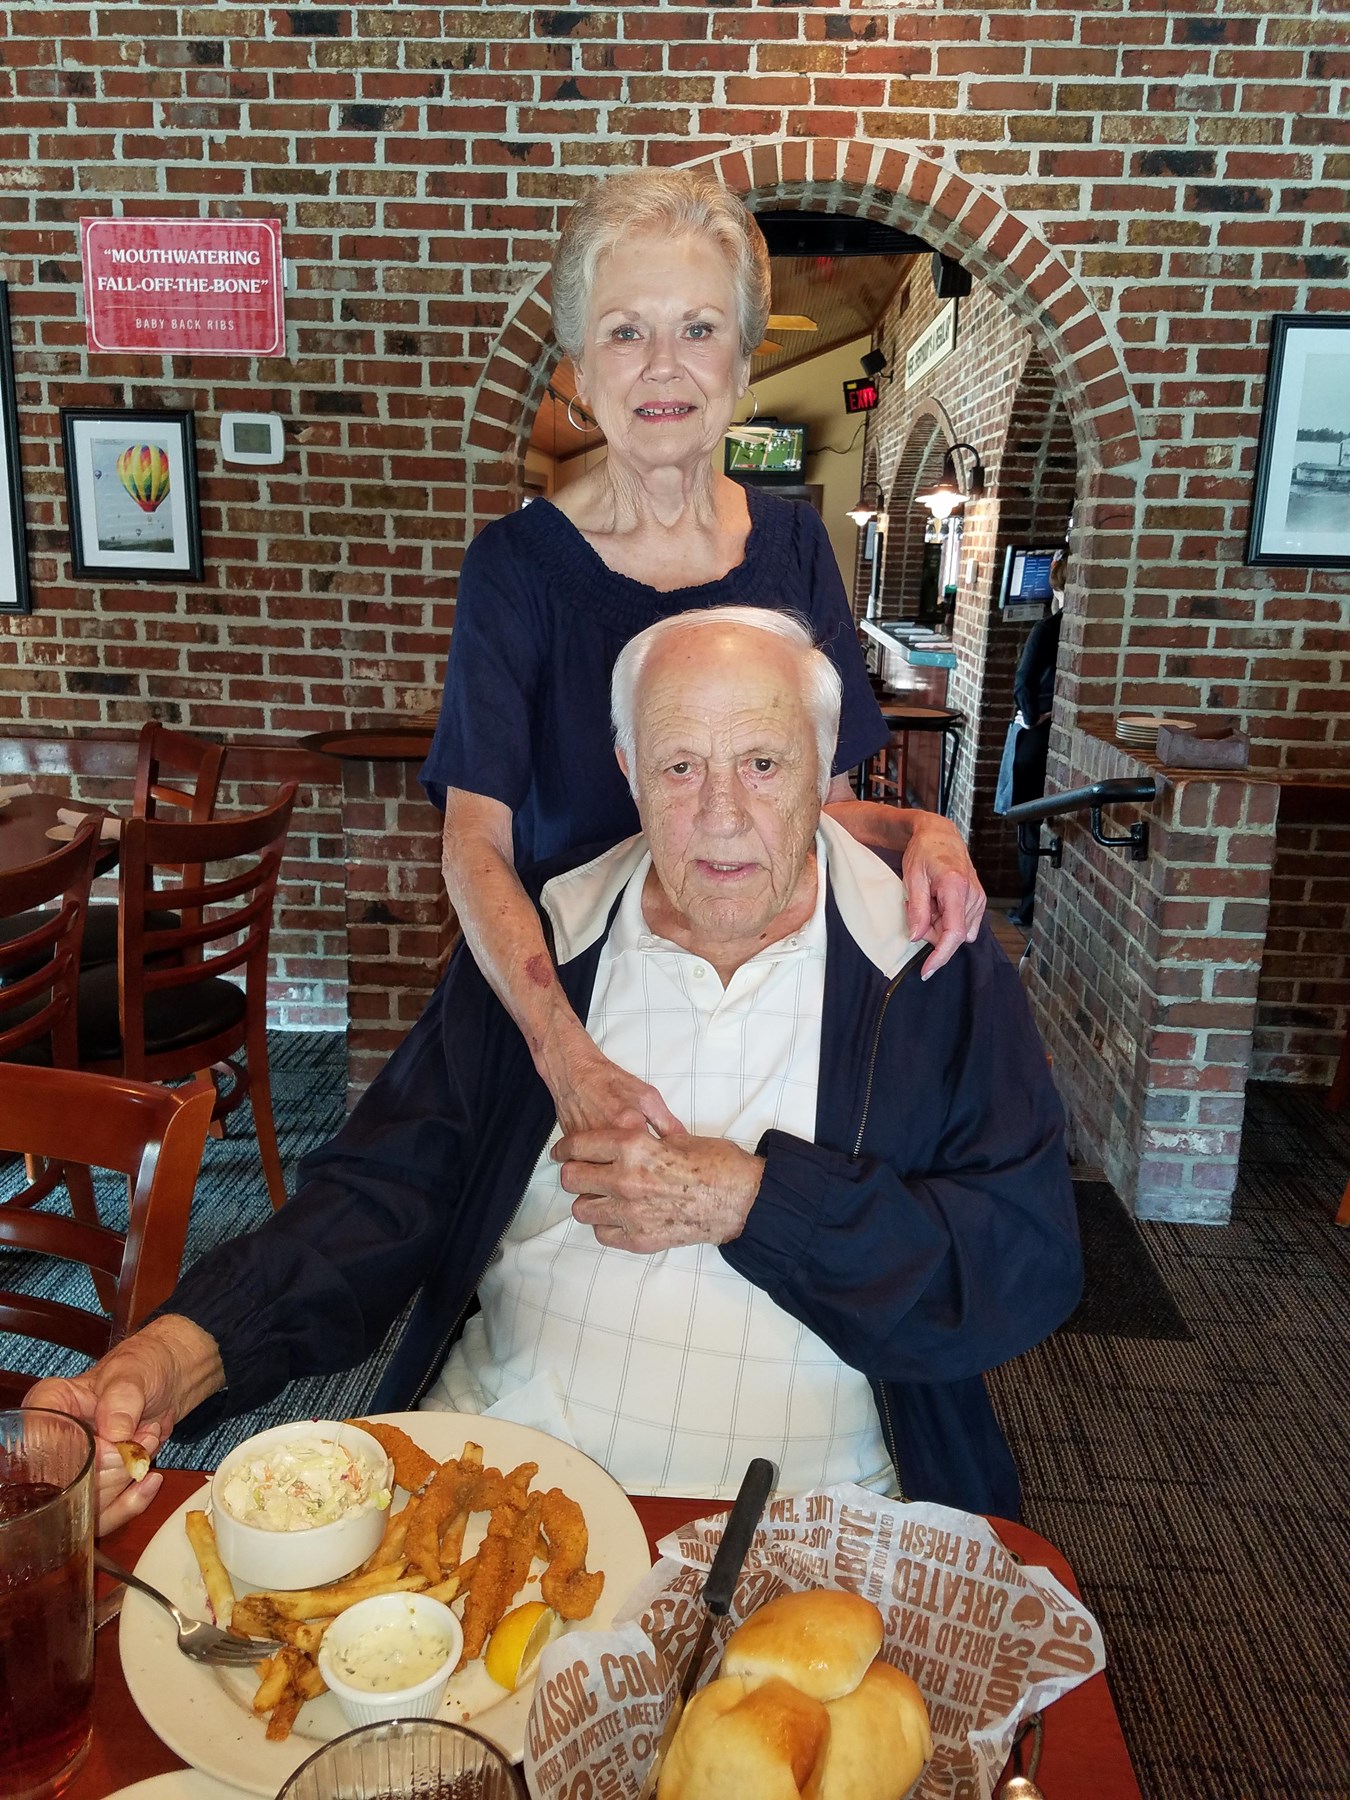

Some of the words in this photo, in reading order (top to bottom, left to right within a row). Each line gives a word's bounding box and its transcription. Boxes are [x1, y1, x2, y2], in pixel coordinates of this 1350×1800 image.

[103, 248, 260, 265] "MOUTHWATERING
[97, 277, 269, 294] FALL-OFF-THE-BONE"
[135, 318, 165, 329] BABY
[171, 319, 201, 330] BACK
[207, 320, 235, 331] RIBS
[849, 387, 874, 410] EXIT
[806, 1496, 834, 1523] LIKE
[799, 1526, 833, 1549] JUST
[834, 1504, 877, 1596] ABOVE
[900, 1520, 961, 1567] FRESH
[965, 1538, 982, 1572] &
[871, 1551, 888, 1570] YOU
[866, 1570, 886, 1598] HAVE
[891, 1557, 1009, 1633] CREATED
[886, 1604, 931, 1650] WAS
[935, 1622, 1000, 1671] BREAD
[949, 1667, 984, 1706] THE
[975, 1632, 1036, 1731] TIONS
[528, 1660, 598, 1763] CLASSIC
[534, 1751, 563, 1796] WHERE
[580, 1709, 625, 1759] APPETITE
